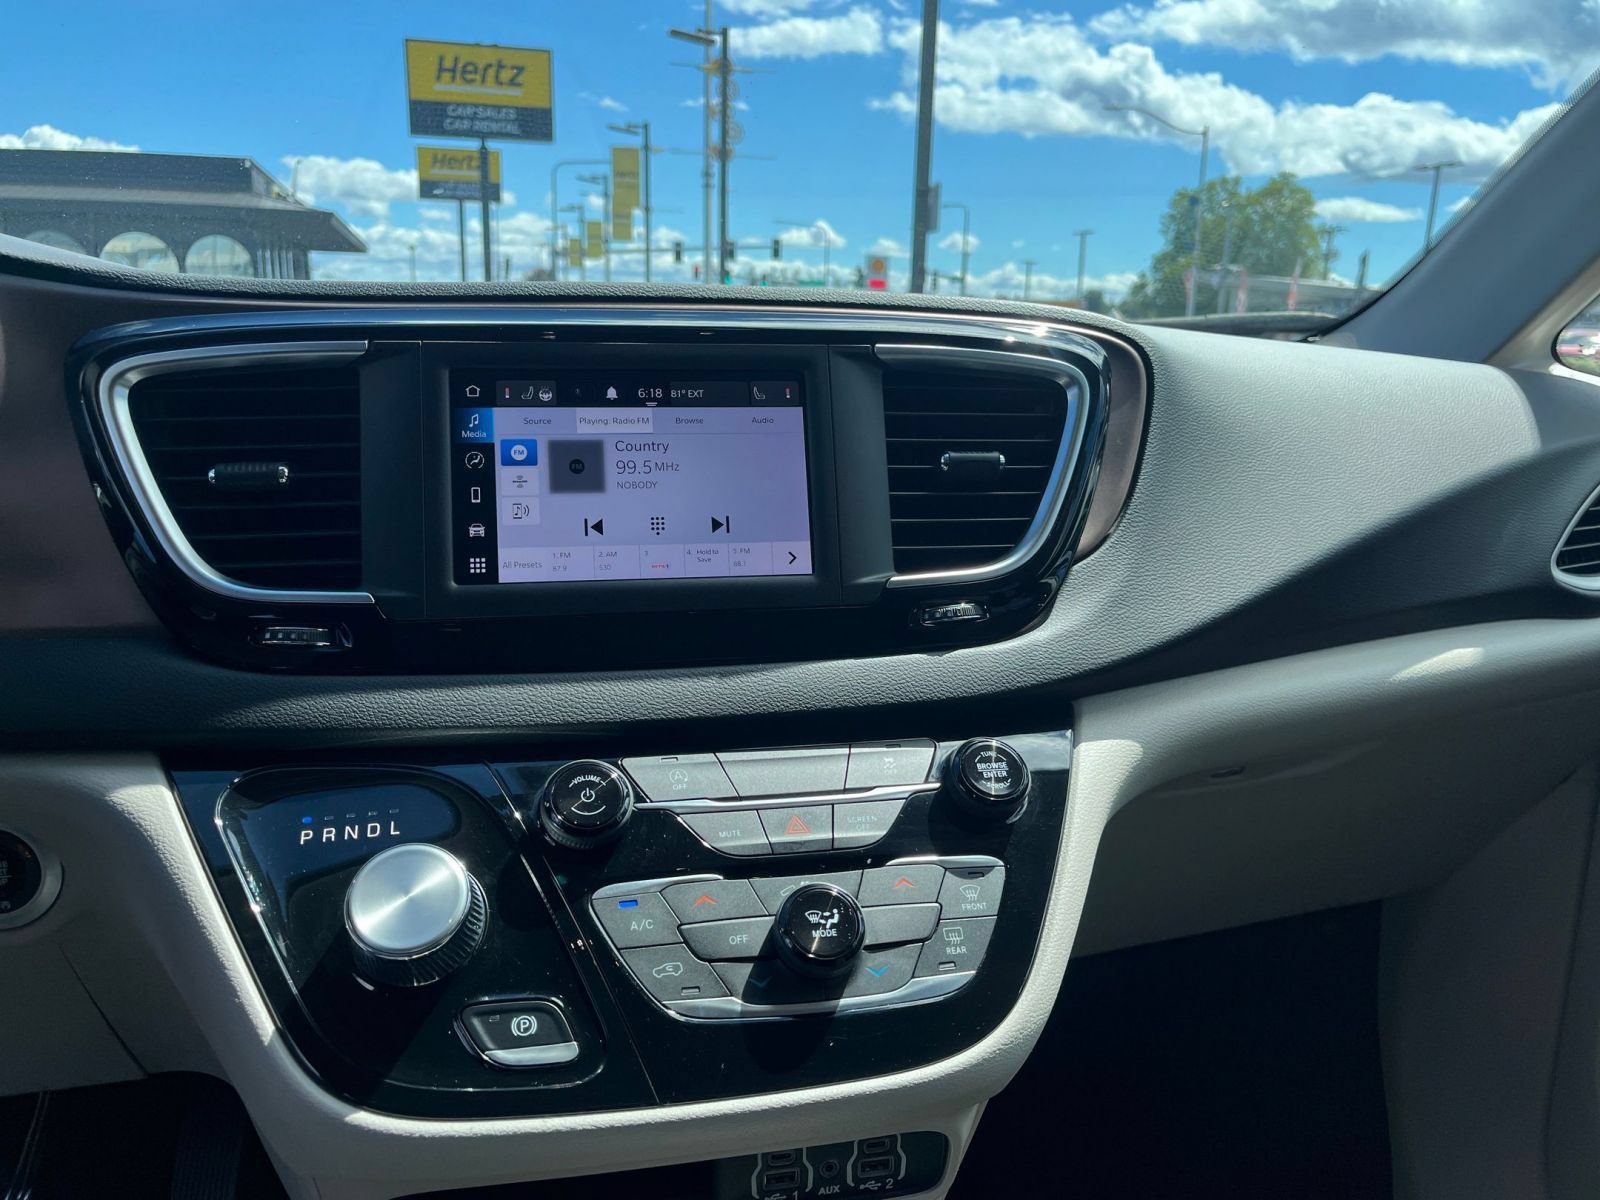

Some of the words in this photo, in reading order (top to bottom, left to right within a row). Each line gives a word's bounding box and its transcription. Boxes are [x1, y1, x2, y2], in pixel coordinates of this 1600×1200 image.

[436, 55, 526, 88] Hertz
[638, 388, 663, 398] 6:18
[688, 389, 704, 398] EXT
[523, 417, 552, 425] Source
[579, 416, 611, 426] Playing:
[613, 416, 636, 425] Radio
[637, 416, 650, 424] FM
[675, 416, 704, 425] Browse
[752, 416, 775, 425] Audio
[461, 429, 487, 439] Media
[513, 448, 525, 456] FM
[615, 440, 669, 454] Country
[616, 459, 652, 475] 99.5
[654, 461, 680, 473] MHz
[616, 480, 659, 490] NOBODY
[696, 548, 712, 556] Hold
[502, 560, 512, 569] All
[513, 559, 543, 569] Presets
[976, 761, 1008, 770] BROWSE
[571, 774, 602, 785] VOLUME
[982, 770, 1008, 779] ENTER
[672, 783, 687, 791] OFF
[300, 830, 313, 845] P
[322, 828, 336, 843] R
[344, 825, 359, 840] N
[367, 823, 381, 838] D
[390, 821, 400, 835] L
[718, 830, 741, 838] MUTE
[961, 902, 987, 911] FRONT
[630, 919, 654, 931] A/C
[812, 929, 838, 938] MODE
[729, 935, 749, 945] OFF
[946, 946, 968, 955] REAR
[885, 1178, 894, 1190] 2
[818, 1185, 840, 1196] AUX
